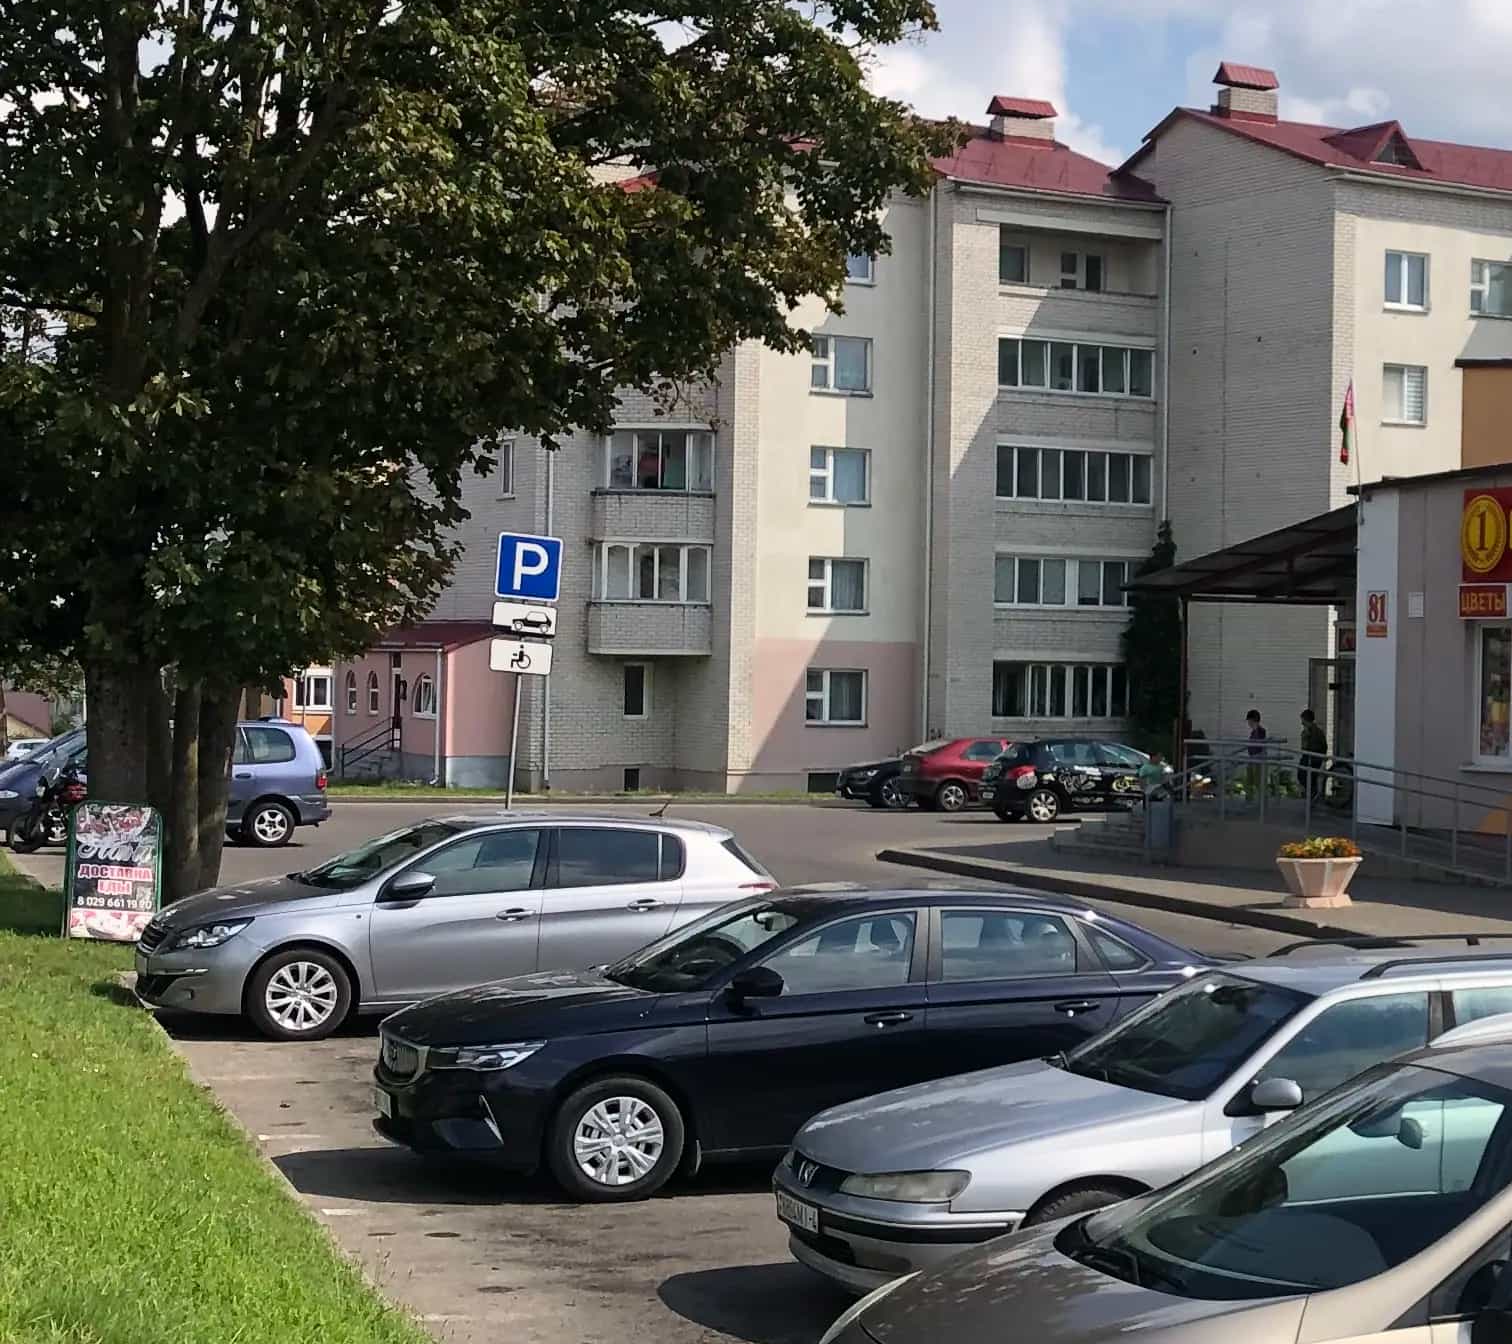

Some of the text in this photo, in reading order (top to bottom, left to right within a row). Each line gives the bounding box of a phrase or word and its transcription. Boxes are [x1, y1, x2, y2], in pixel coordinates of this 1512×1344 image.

[512, 541, 549, 591] P
[1368, 593, 1387, 623] 81
[1461, 592, 1506, 614] ЦВЕТЫ
[78, 864, 153, 881] ДОСТАВКА
